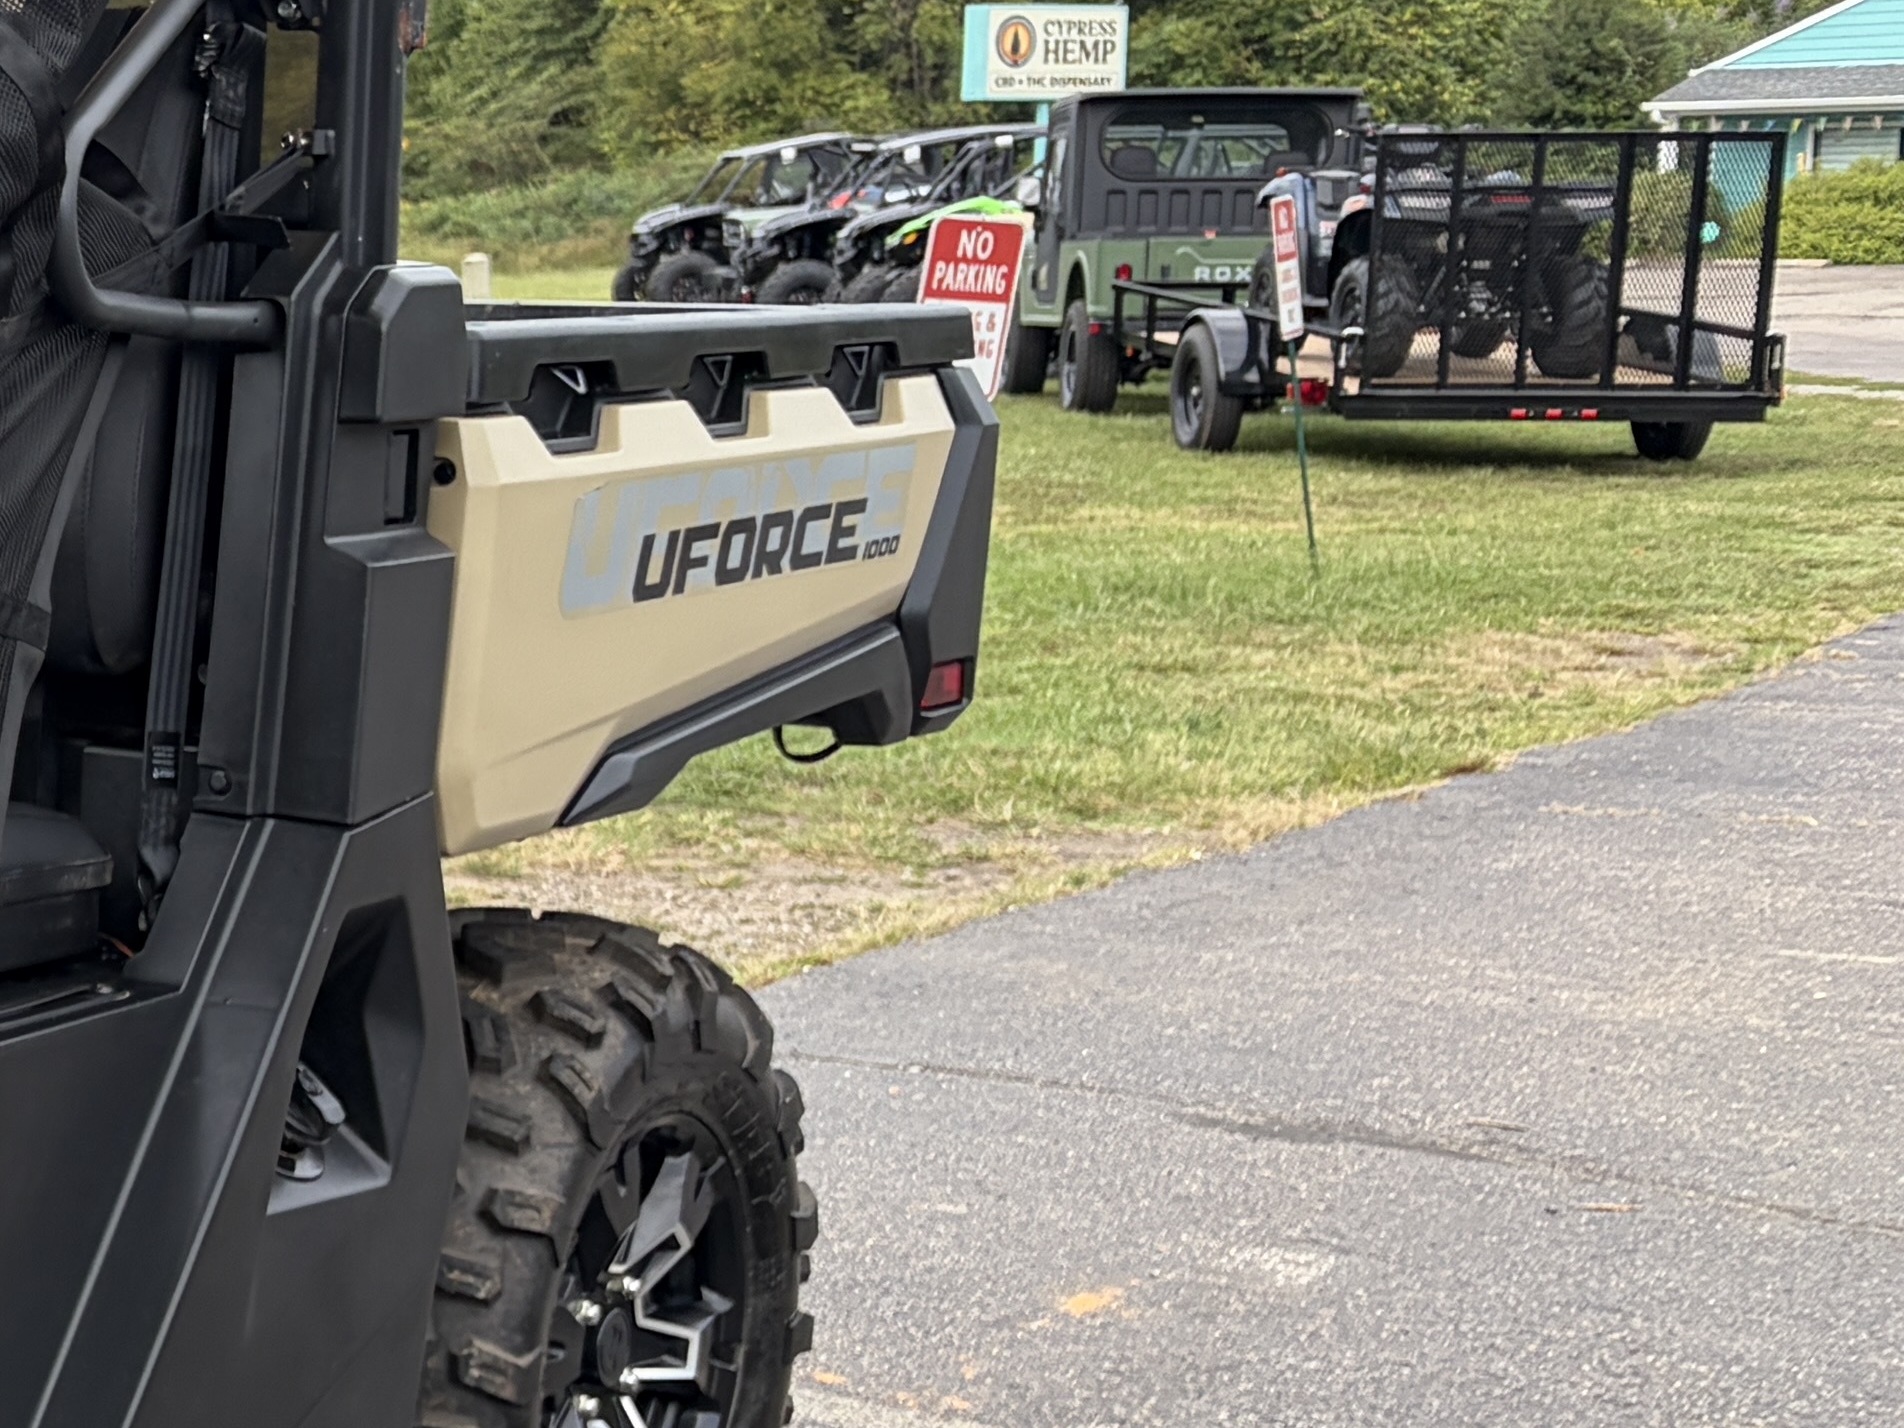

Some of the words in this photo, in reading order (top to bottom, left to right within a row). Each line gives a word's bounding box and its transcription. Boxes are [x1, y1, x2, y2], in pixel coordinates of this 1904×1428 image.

[1043, 19, 1117, 37] CYPRESS
[1043, 39, 1116, 64] HEMP
[995, 77, 1016, 88] CBD
[1050, 76, 1112, 88] DISPENSARY
[957, 227, 994, 260] NO
[931, 260, 1008, 295] PARKING
[1194, 265, 1254, 282] ROX
[632, 497, 869, 603] UFORCE
[862, 534, 901, 562] 1000
